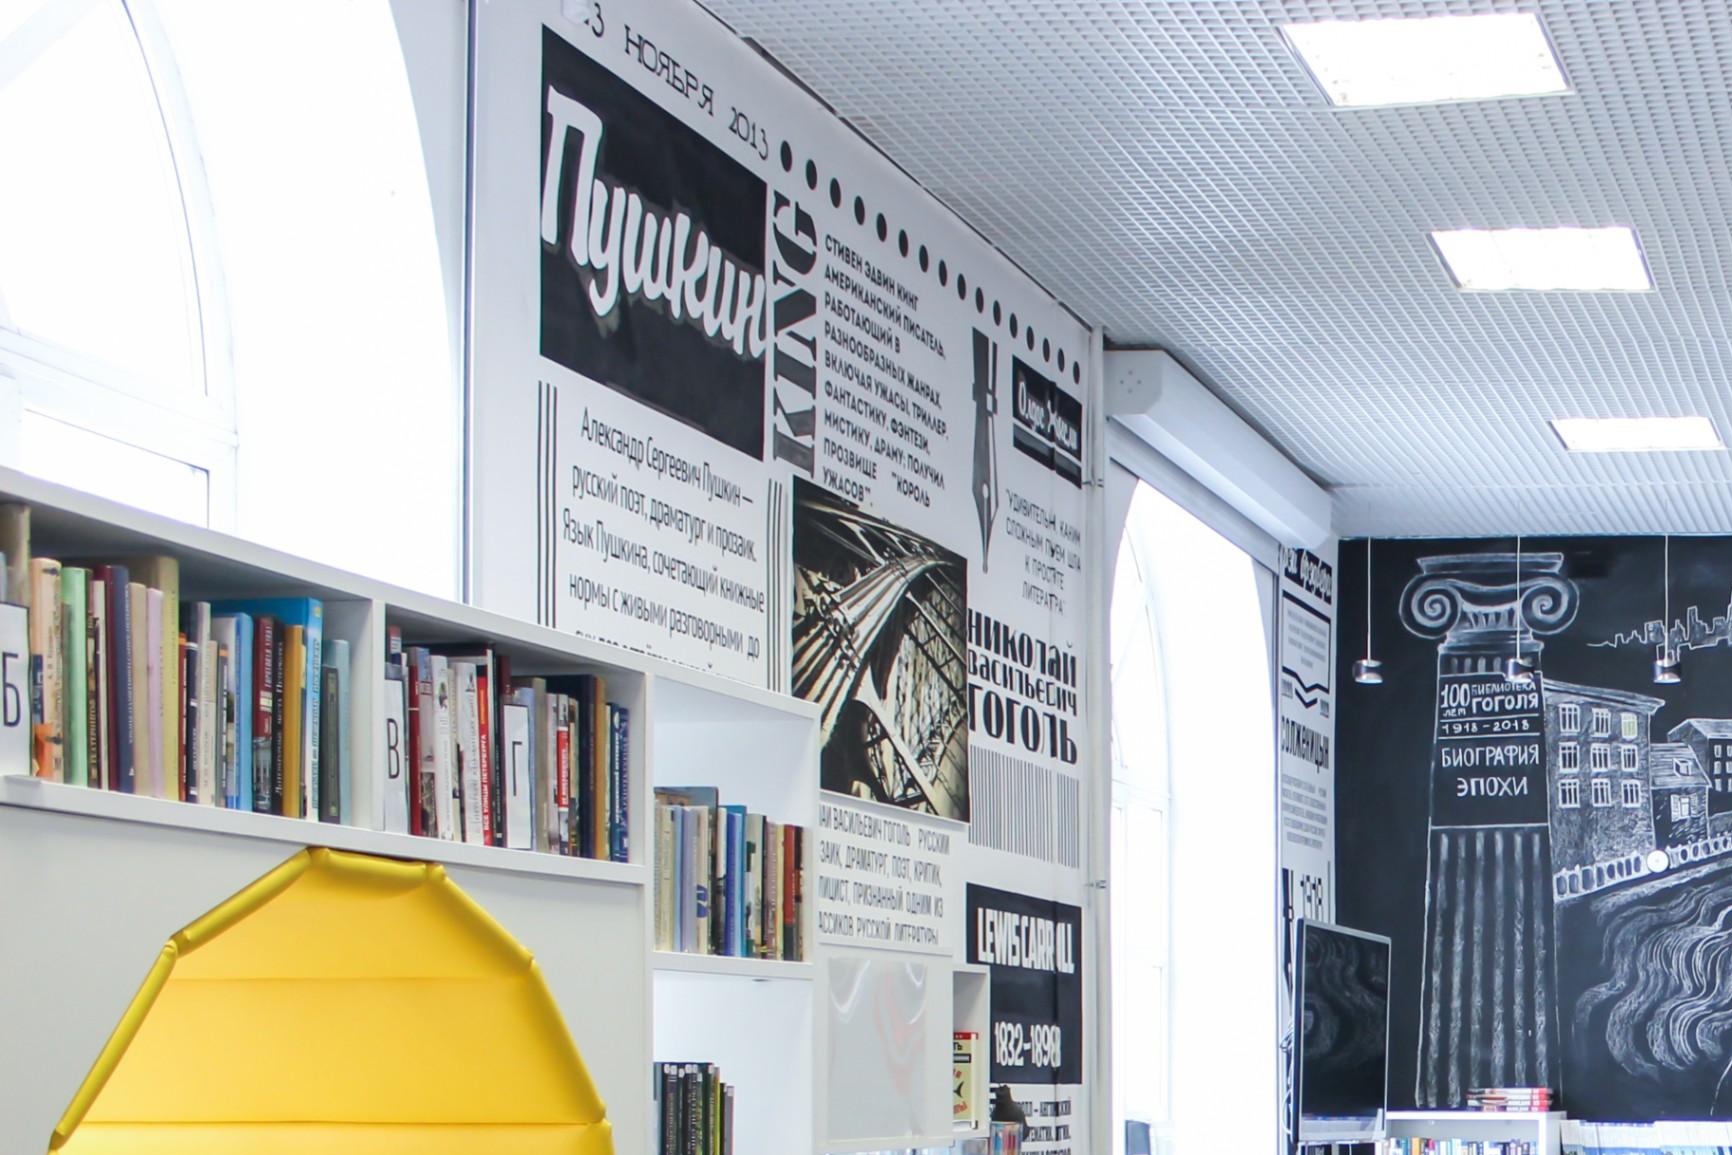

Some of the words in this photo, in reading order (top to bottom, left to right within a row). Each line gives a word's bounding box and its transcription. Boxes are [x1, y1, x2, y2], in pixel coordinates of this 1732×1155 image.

[624, 24, 715, 116] НОЯБРЯ
[728, 107, 768, 161] 2013
[541, 85, 766, 358] Пушкин
[824, 264, 901, 322] АМЕРИКАНСКИЙ
[825, 234, 863, 274] СТИВЕН
[865, 261, 895, 292] ЭДВИН
[896, 281, 919, 311] КИНГ
[773, 190, 817, 479] KING
[825, 292, 892, 348] РАБОТАЮЩИЙ
[895, 333, 901, 354] В
[825, 321, 905, 382] РАЗНООБРАЗНЫХ
[825, 350, 872, 392] ВКЛЮЧАЯ
[581, 406, 644, 471] Александр
[646, 436, 700, 489] Сергеевич
[703, 462, 741, 507] Пушкин
[824, 438, 877, 482] ПРОЗВИЩЕ
[907, 453, 945, 490] ПОЛУЧИЛ
[572, 465, 618, 501] русский
[620, 484, 648, 521] поэт,
[649, 497, 706, 545] драматург
[715, 526, 757, 562] прозаик.
[563, 508, 593, 550] Язык
[596, 520, 650, 575] Пушкина,
[652, 547, 718, 597] сочетающий
[719, 573, 765, 613] книжные
[569, 574, 610, 610] нормы
[620, 593, 667, 629] живыми
[669, 608, 743, 655] разговорными
[747, 634, 760, 661] до
[3, 653, 21, 726] Б
[1441, 684, 1471, 708] 100
[1471, 681, 1536, 695] БИБЛИОТЕКА
[1472, 692, 1539, 714] ГОГОЛЯ
[387, 718, 400, 779] В
[512, 741, 522, 796] Г
[1442, 744, 1539, 768] БИОГРАФИЯ
[1457, 776, 1528, 797] ЭПОХИ
[977, 907, 1020, 967] LEWIS
